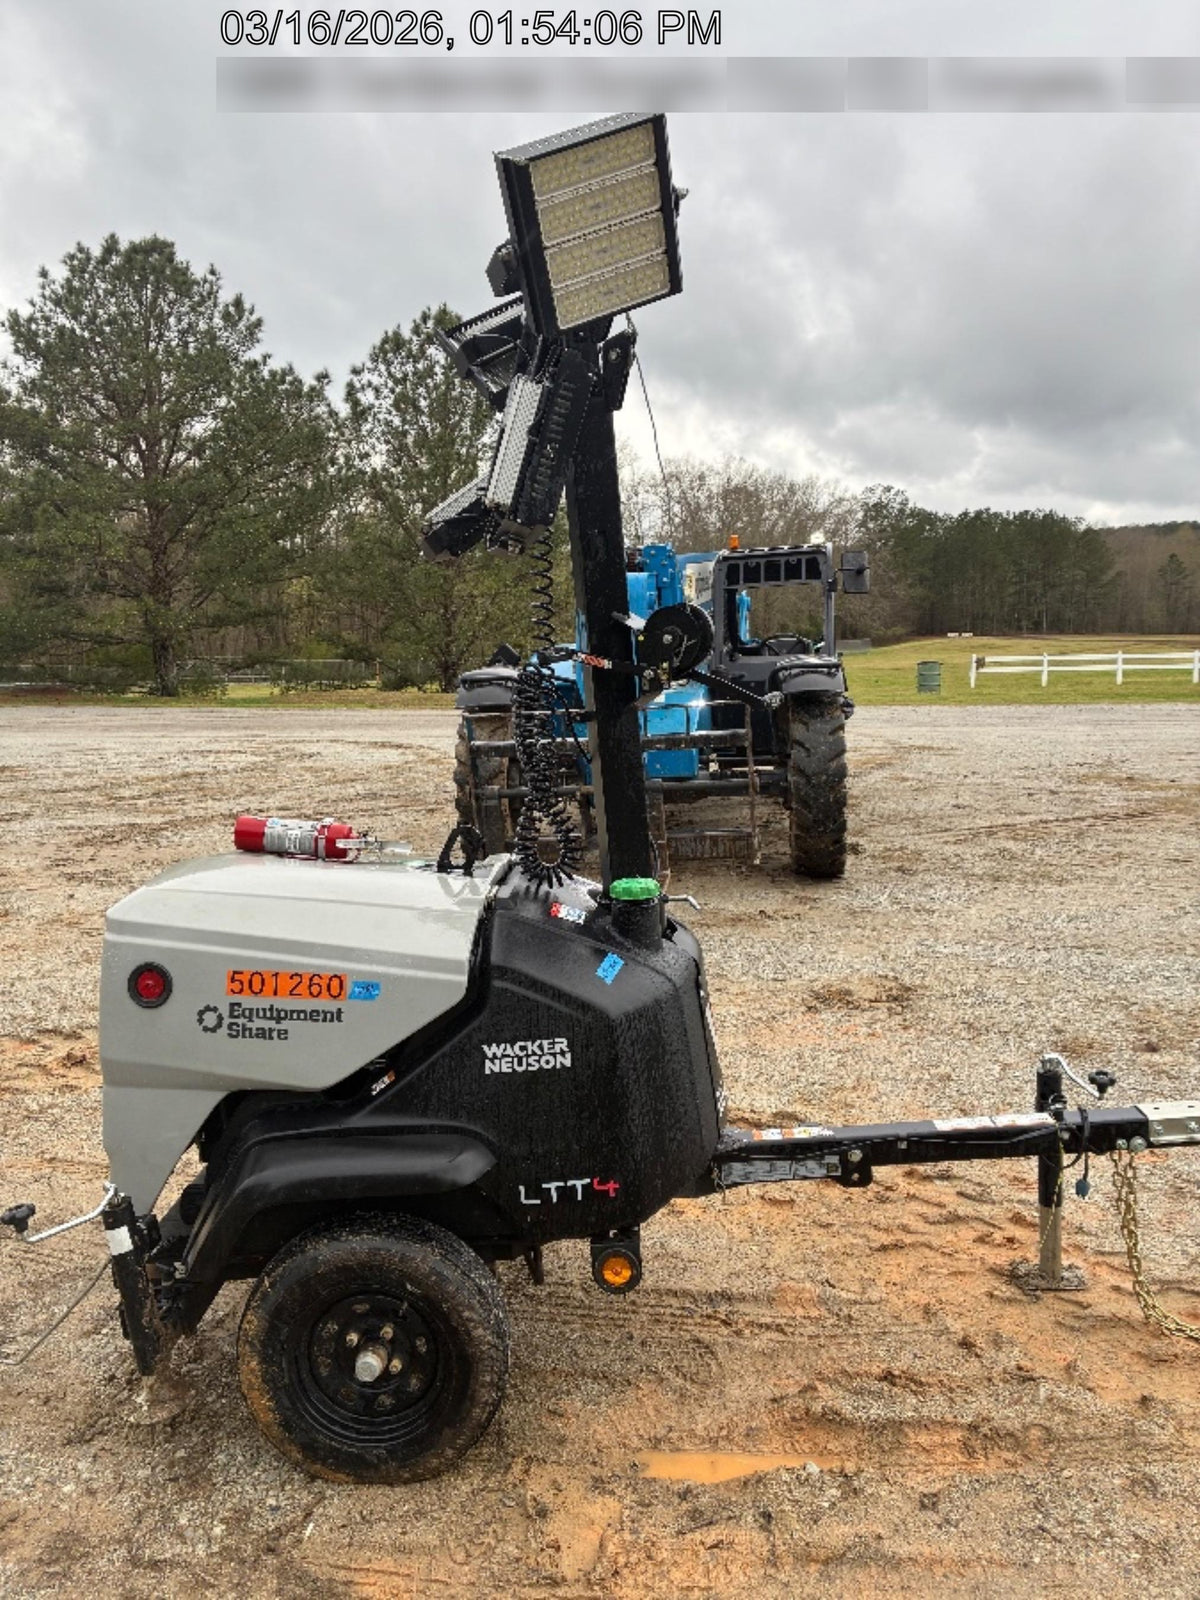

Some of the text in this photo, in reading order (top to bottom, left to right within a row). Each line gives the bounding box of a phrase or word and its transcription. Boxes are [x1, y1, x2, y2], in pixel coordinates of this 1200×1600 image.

[229, 970, 344, 999] 501260
[228, 1002, 344, 1024] Equipment
[227, 1022, 289, 1041] Share
[481, 1038, 570, 1059] WACKER
[484, 1052, 572, 1075] NEUSON
[518, 1176, 620, 1205] LTT4
